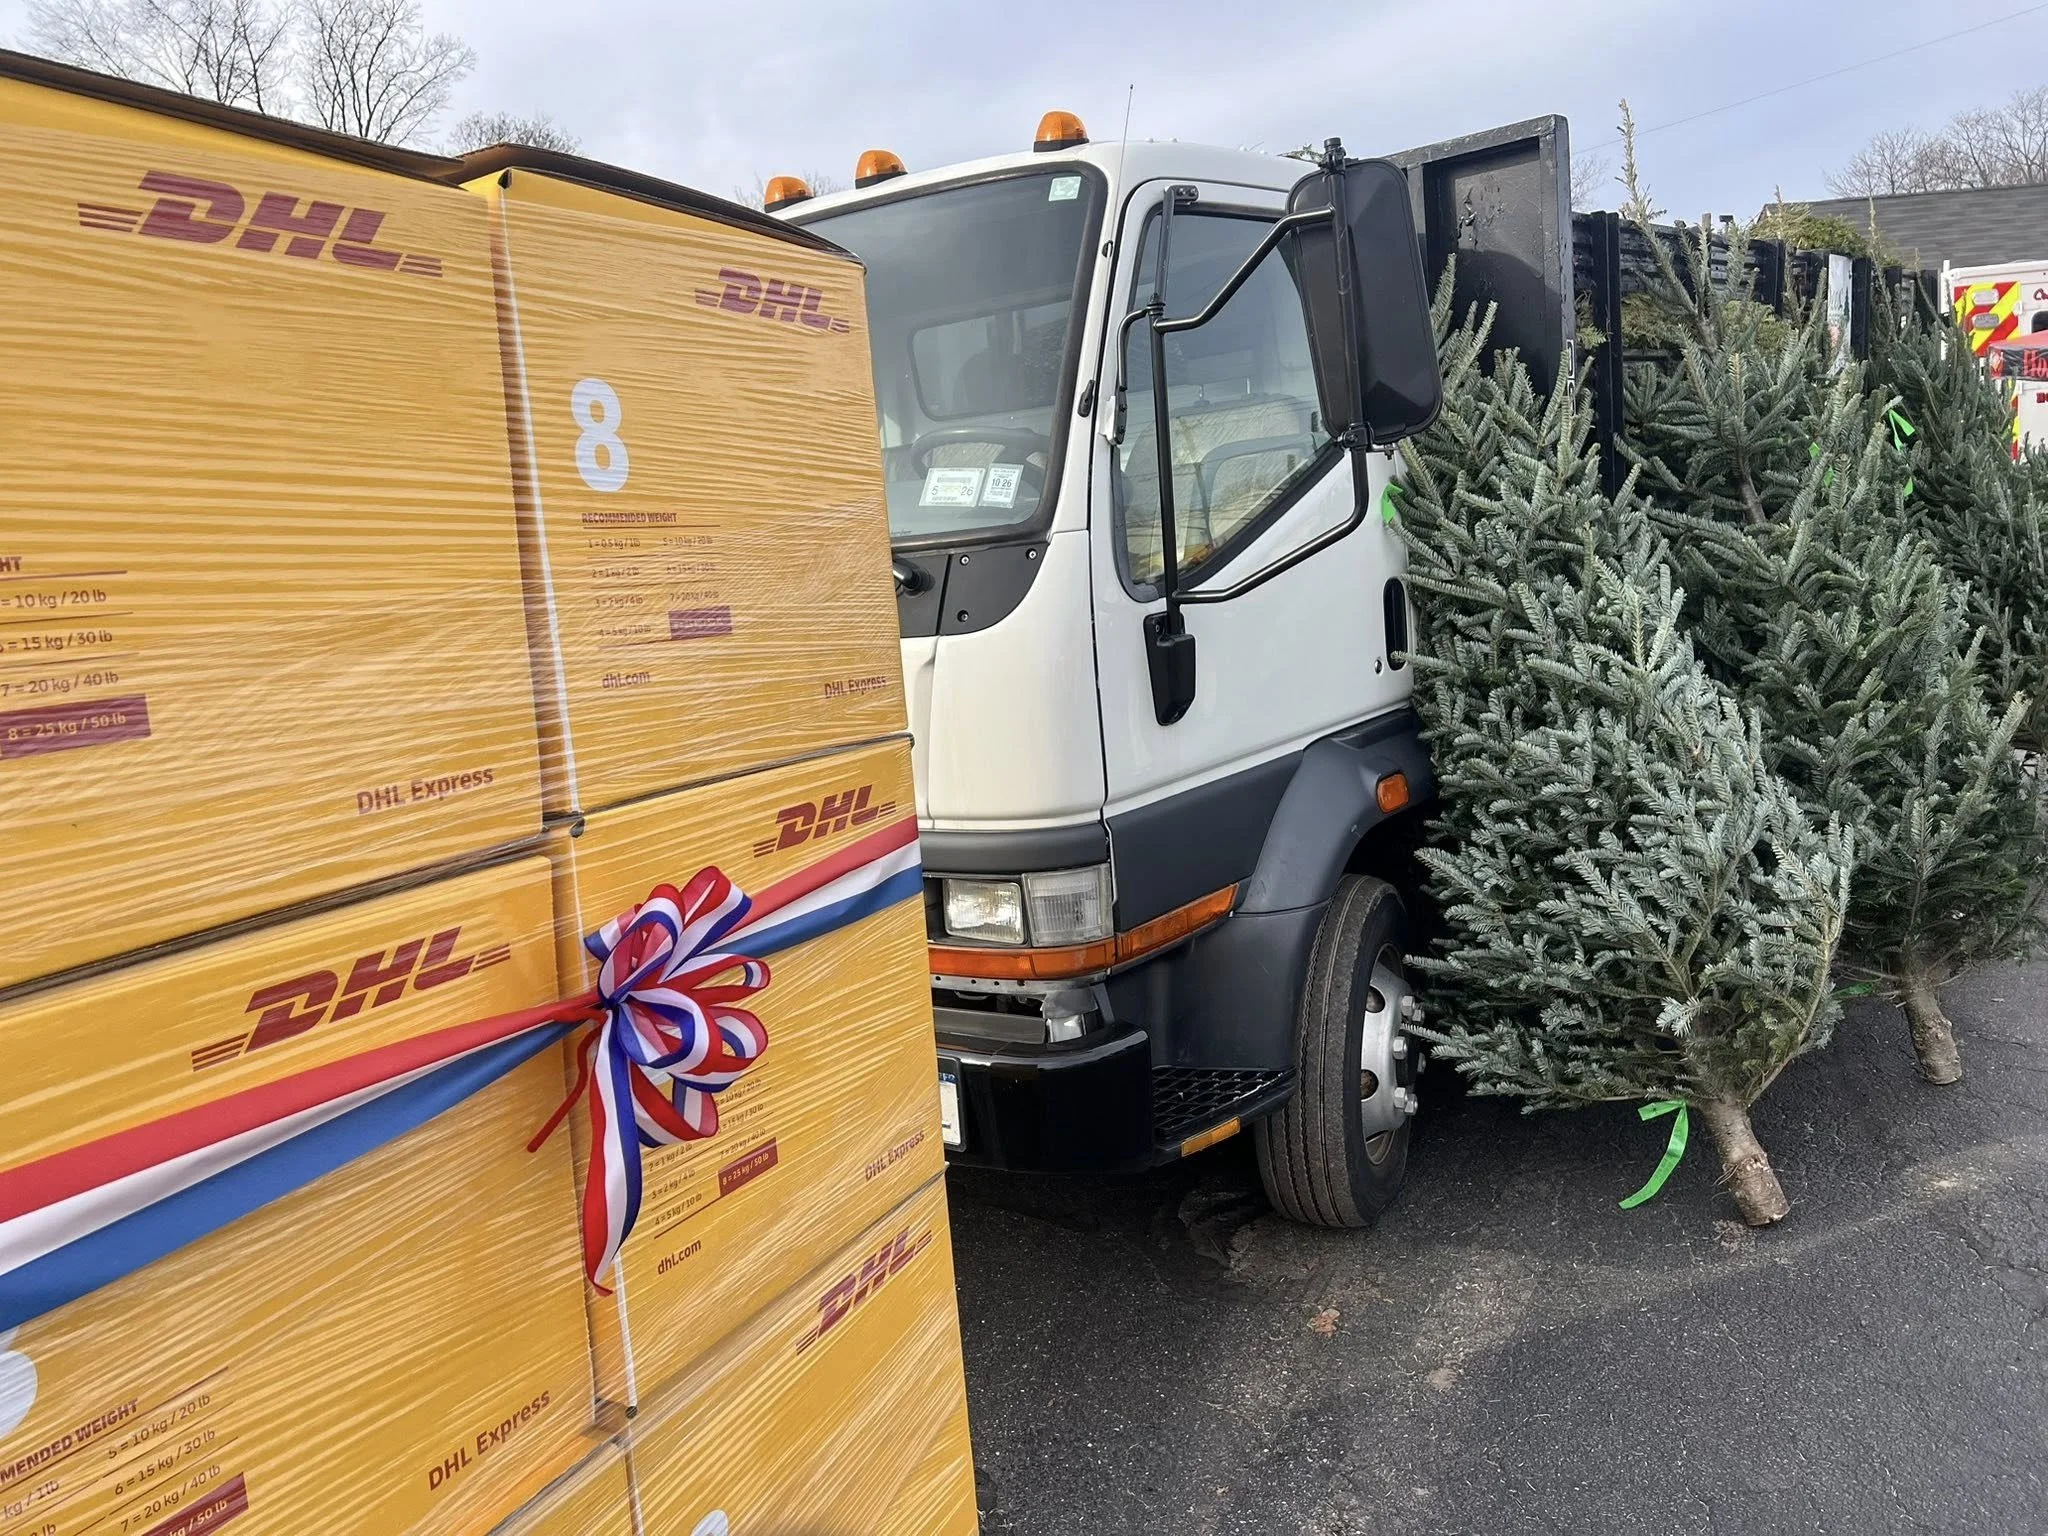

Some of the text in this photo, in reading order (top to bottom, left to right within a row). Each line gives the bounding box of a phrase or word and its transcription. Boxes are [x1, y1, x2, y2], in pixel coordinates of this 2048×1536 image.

[138, 170, 403, 271] DHL
[718, 267, 832, 331] DHL
[571, 378, 629, 492] 8
[1002, 478, 1013, 488] 26
[581, 512, 678, 523] RECOMMENDED WEIGHT
[14, 594, 35, 608] 10
[38, 593, 57, 609] kg
[70, 590, 90, 604] 20
[92, 589, 107, 603] lb
[20, 637, 42, 650] 15
[44, 635, 63, 650] kg
[76, 631, 97, 645] 30
[98, 630, 113, 643] lb
[0, 683, 10, 697] 7
[28, 679, 49, 693] 20
[51, 678, 71, 693] kg
[83, 673, 102, 687] 40
[105, 671, 119, 684] lb
[602, 671, 650, 689] dhl.com
[824, 681, 848, 699] DHL
[7, 727, 19, 740] 8
[36, 722, 55, 737] 25
[57, 720, 77, 735] kg
[91, 714, 110, 729] 50
[112, 712, 126, 725] lb
[356, 768, 494, 815] DHL Express
[775, 784, 880, 852] DHL
[244, 925, 477, 1055] DHL
[733, 1169, 741, 1179] 25
[754, 1155, 762, 1167] 50
[865, 1130, 925, 1181] DHL Express
[657, 1240, 702, 1275] dhl.com
[817, 1225, 917, 1339] DHL
[75, 1398, 138, 1441] WEIGHT
[108, 1449, 117, 1459] 5
[132, 1428, 149, 1447] 10
[152, 1419, 168, 1433] kg
[180, 1402, 196, 1419] 20
[198, 1394, 210, 1409] lb
[428, 1390, 550, 1491] DHL Express
[115, 1483, 124, 1495] 6
[139, 1464, 155, 1481] 15
[157, 1455, 174, 1471] kg
[184, 1437, 201, 1455] 30
[203, 1429, 216, 1444] lb
[4, 1501, 22, 1519] kg
[121, 1518, 129, 1533] 7
[144, 1501, 161, 1519] 20
[164, 1491, 180, 1507] kg
[190, 1472, 207, 1490] 40
[208, 1463, 221, 1479] lb
[197, 1507, 213, 1525] 50
[215, 1498, 228, 1513] lb
